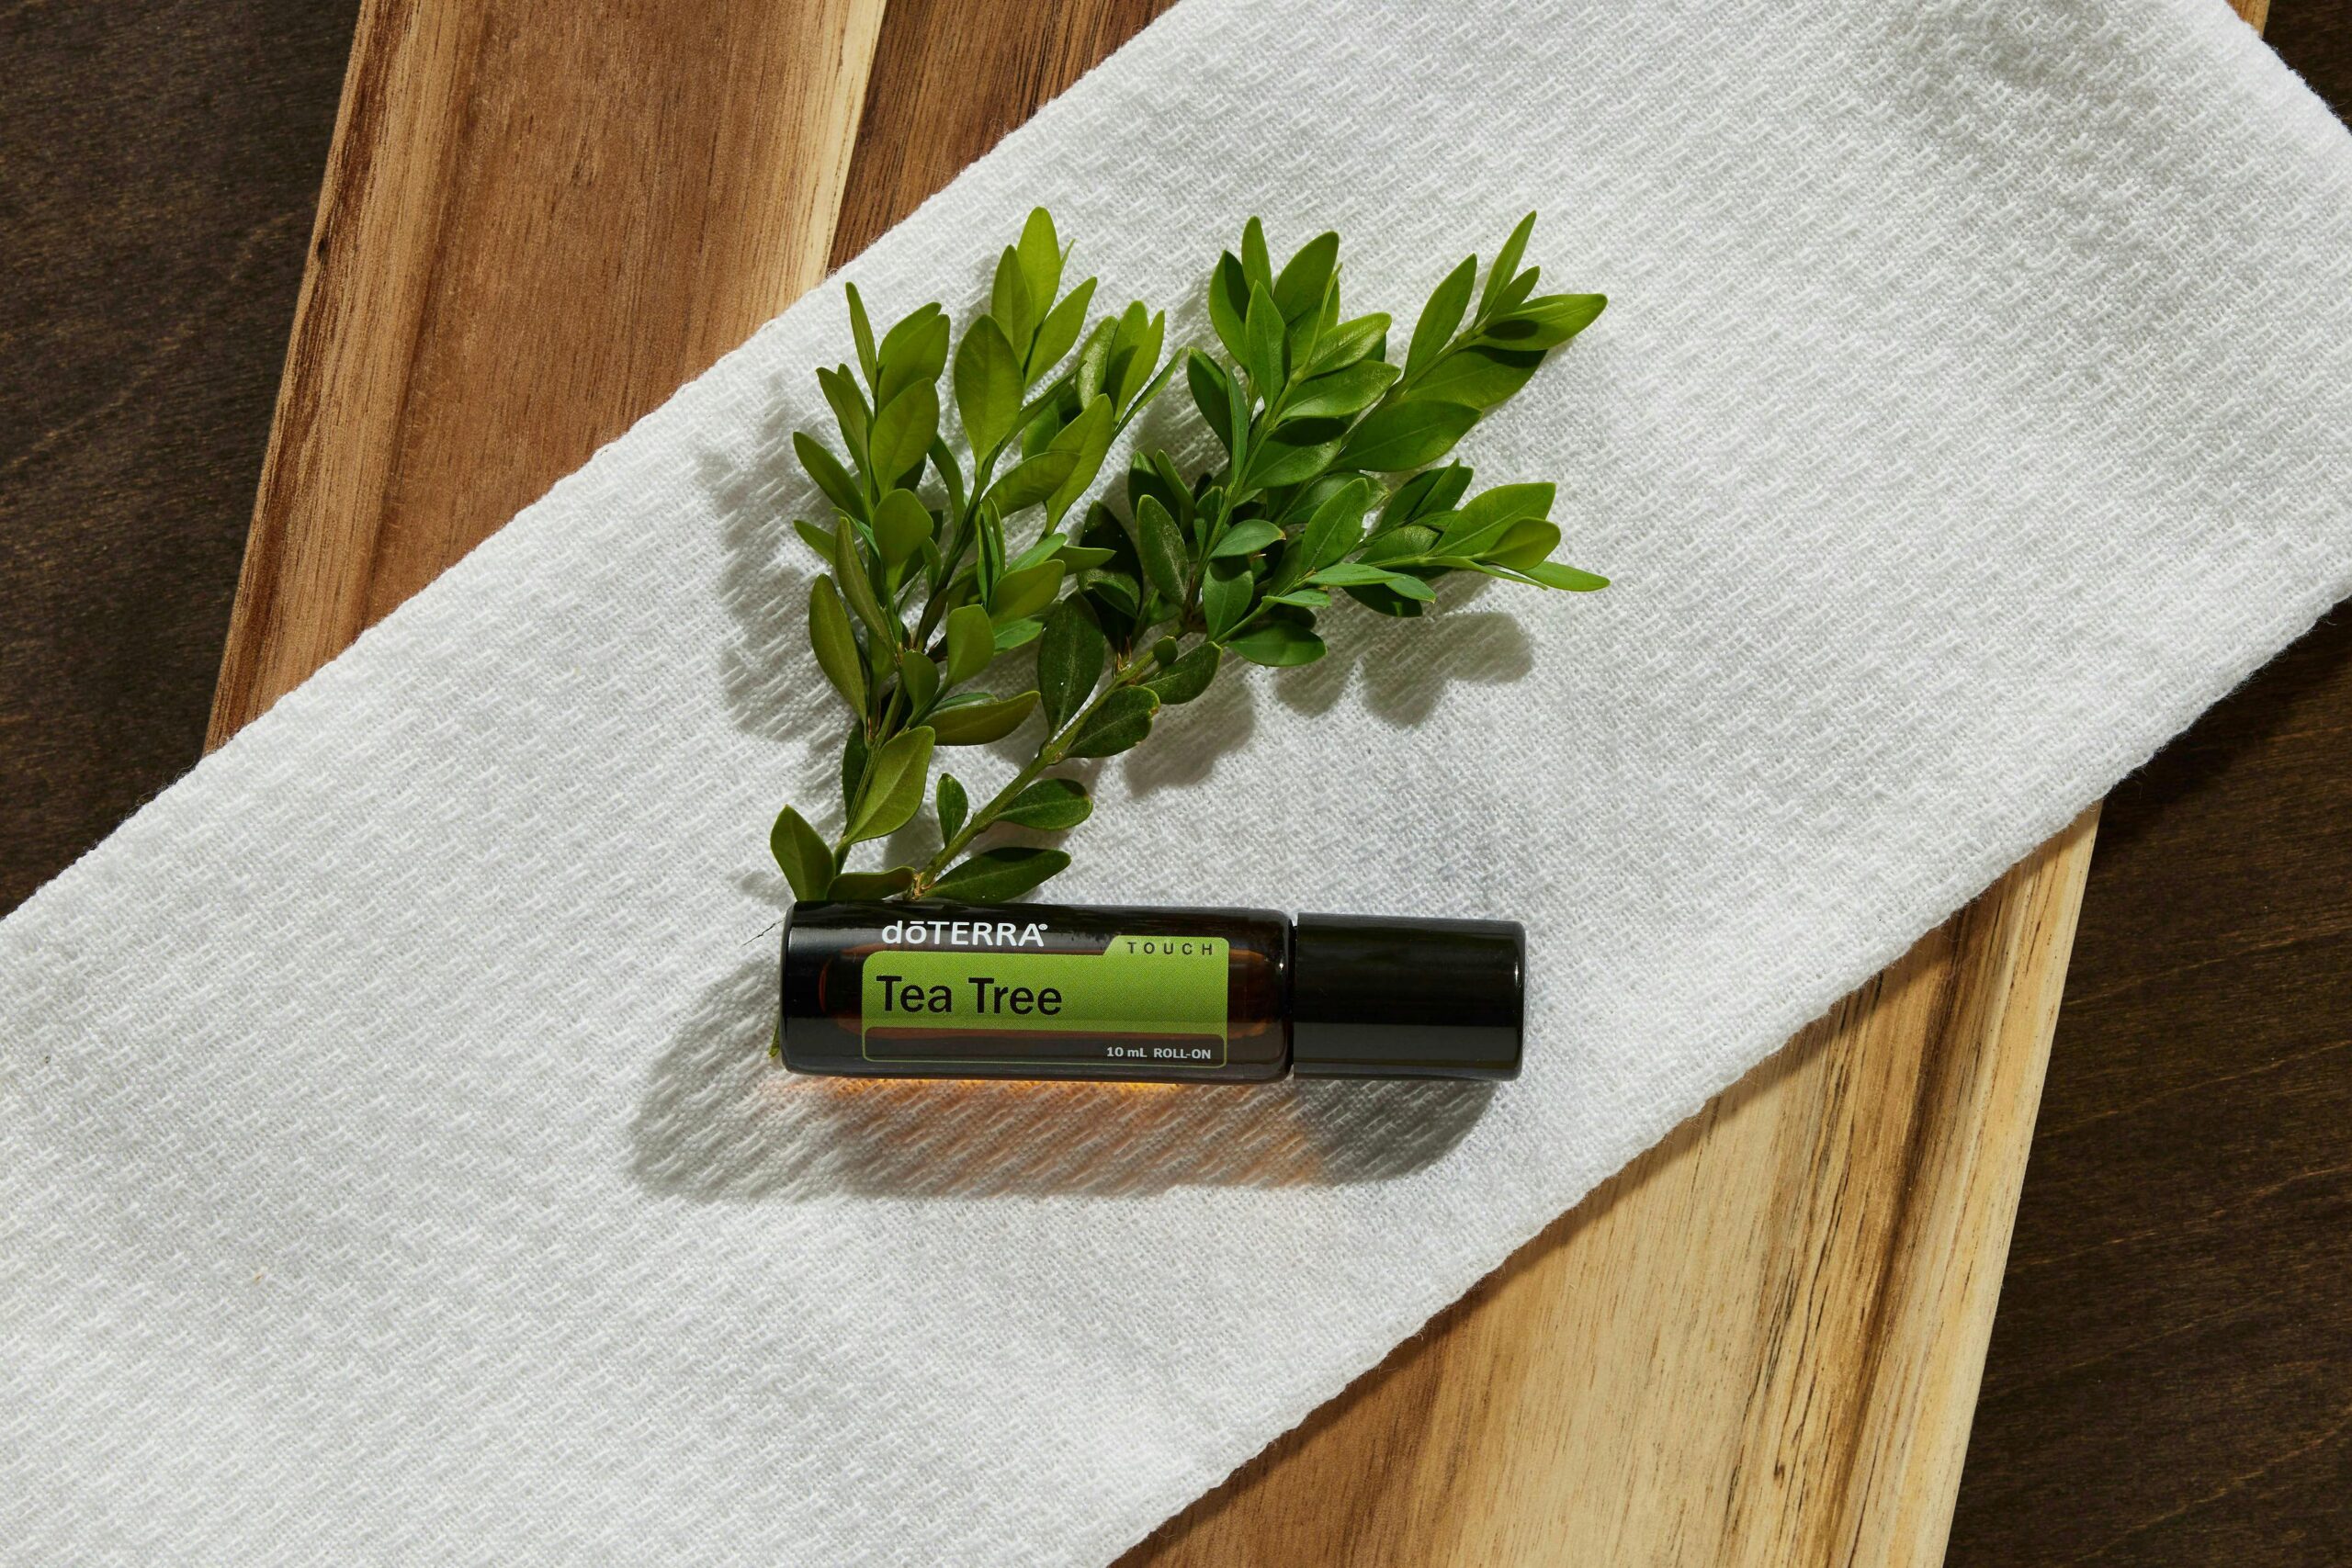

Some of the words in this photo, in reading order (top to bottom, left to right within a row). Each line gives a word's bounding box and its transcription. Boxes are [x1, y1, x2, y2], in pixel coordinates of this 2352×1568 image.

[1127, 942, 1213, 956] TOUCH
[876, 975, 953, 1013] Tea
[967, 976, 1062, 1015] Tree
[1106, 1046, 1124, 1057] 10
[1127, 1047, 1148, 1058] mL
[1153, 1047, 1212, 1059] ROLL-ON
